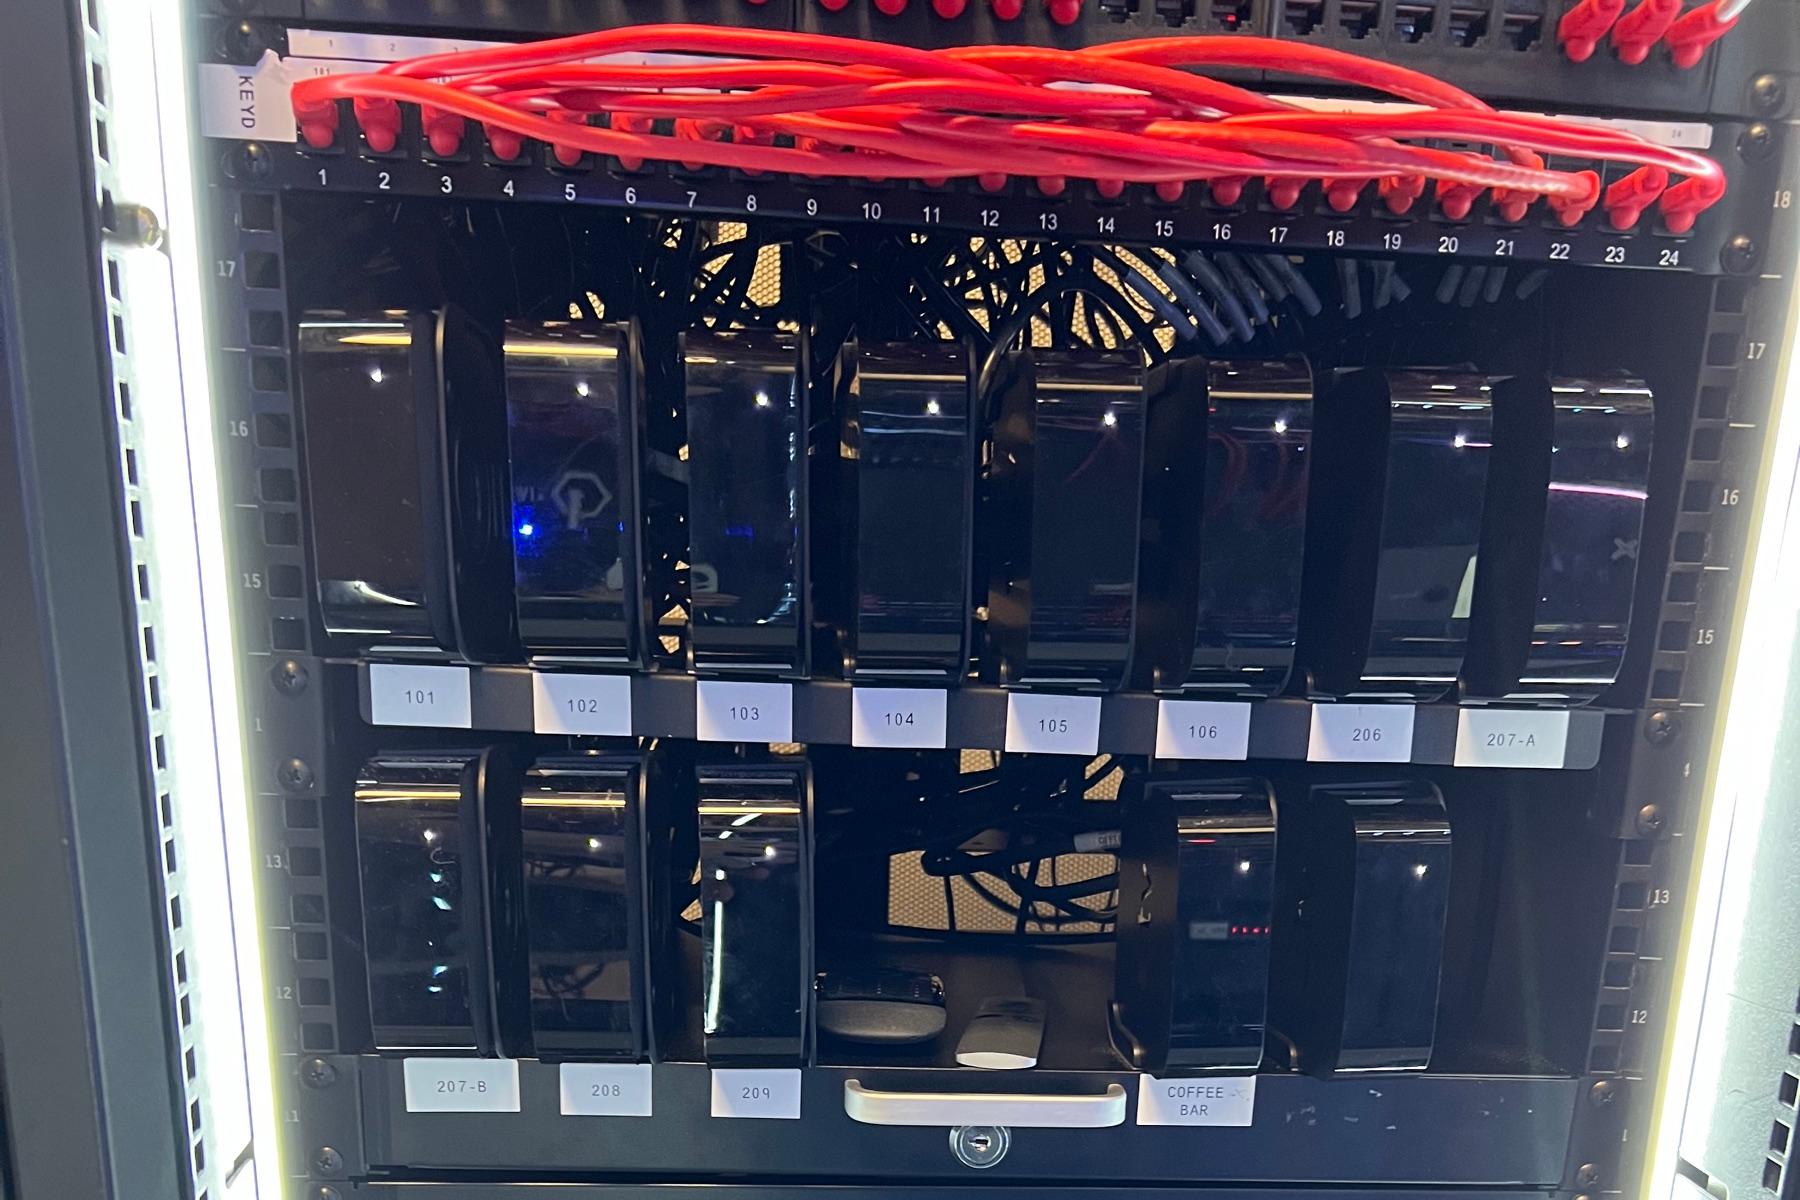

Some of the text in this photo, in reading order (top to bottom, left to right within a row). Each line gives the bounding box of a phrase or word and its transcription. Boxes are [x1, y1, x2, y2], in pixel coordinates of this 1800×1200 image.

[236, 75, 256, 131] KEYD
[1772, 190, 1792, 209] 18
[318, 168, 1679, 266] 1 2 3 4 5 6 7 8 9 10 11 12 13 14 15 16 17 18 19 20 21 22 23 24
[217, 260, 235, 278] 17
[1747, 342, 1767, 359] 17
[228, 420, 248, 437] 16
[1721, 489, 1740, 505] 16
[243, 573, 262, 589] 15
[1695, 628, 1714, 645] 15
[405, 690, 434, 705] 101
[567, 698, 598, 713] 102
[730, 706, 760, 721] 103
[885, 712, 914, 726] 104
[1039, 719, 1068, 733] 105
[1189, 725, 1217, 739] 106
[1352, 728, 1381, 742] 206
[1486, 733, 1536, 747] 207-A
[264, 854, 281, 870] 13
[1652, 889, 1670, 904] 13
[276, 986, 292, 1000] 12
[1629, 1009, 1646, 1024] 12
[437, 1080, 487, 1093] 207-B
[591, 1084, 621, 1097] 208
[742, 1086, 770, 1099] 209
[1167, 1086, 1224, 1099] COFFEE
[1180, 1104, 1209, 1117] BAR
